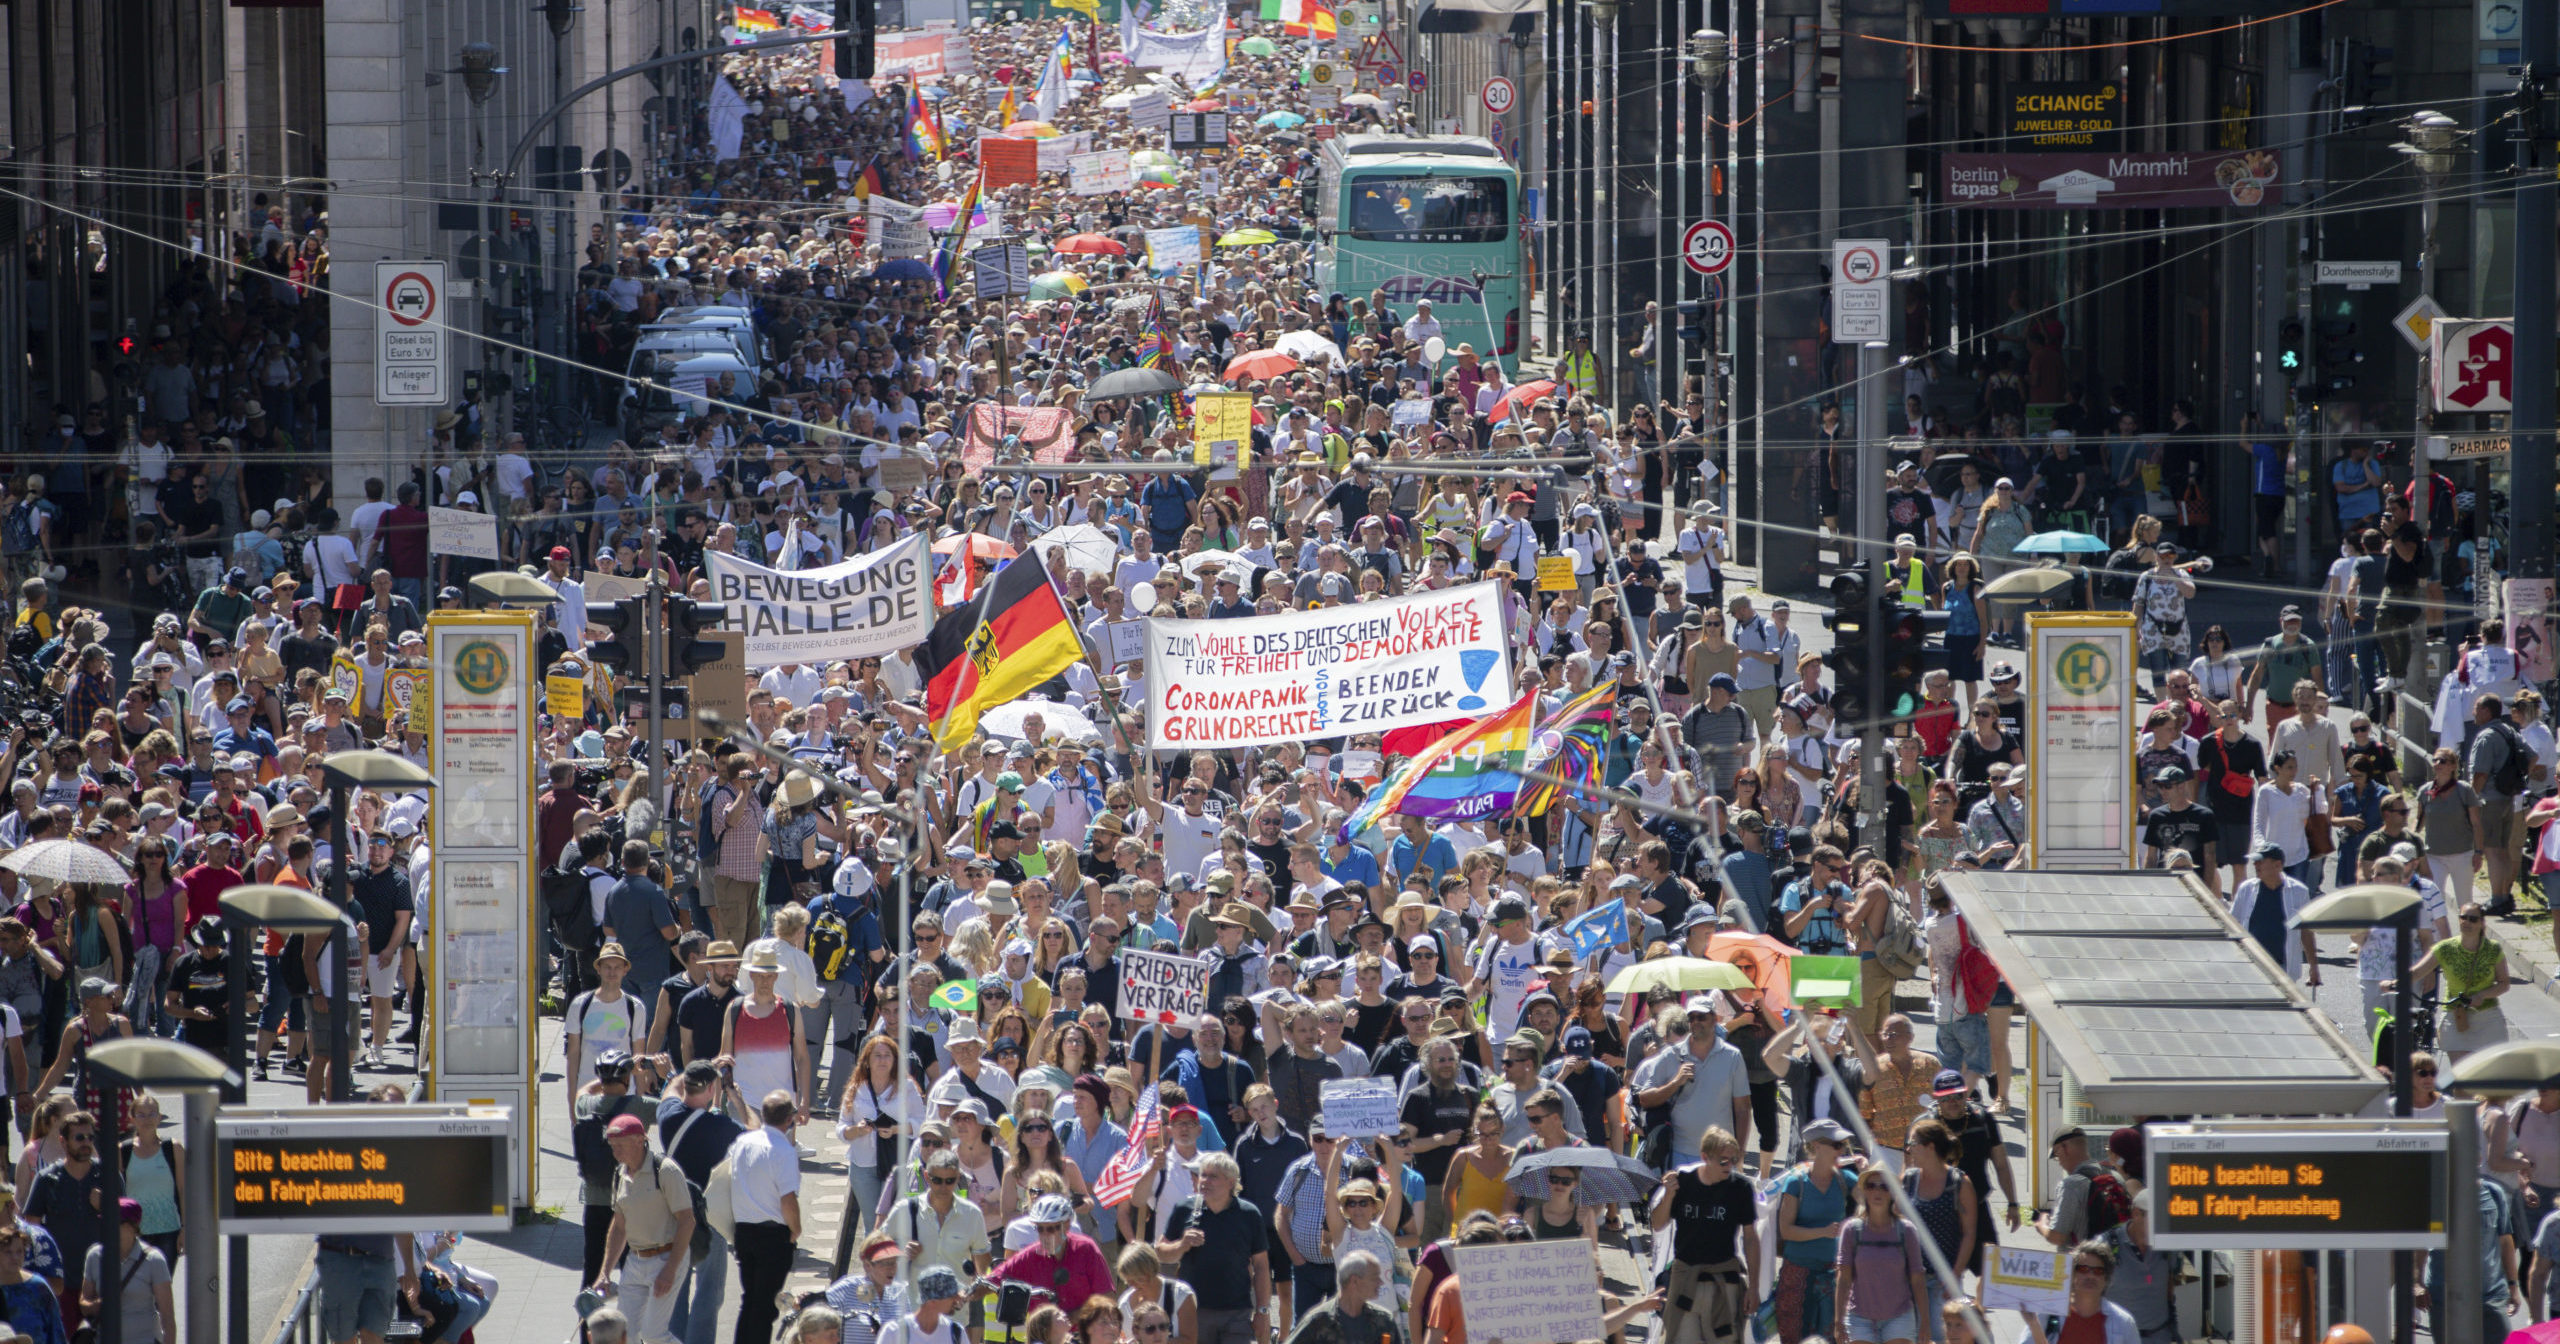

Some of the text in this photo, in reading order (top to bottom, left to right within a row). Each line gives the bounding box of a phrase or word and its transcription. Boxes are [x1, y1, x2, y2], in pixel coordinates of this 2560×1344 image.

[1489, 87, 1508, 103] 30
[2014, 120, 2112, 131] JUWELIER GOLD
[2033, 134, 2094, 144] LEIHHAUS
[1951, 166, 1998, 182] berlin
[2109, 157, 2188, 177] Mmmh!
[1951, 182, 1998, 198] tapas
[1695, 236, 1723, 258] 30
[1352, 253, 1505, 283] REISEN
[1378, 275, 1486, 304] AFAN
[1846, 318, 1876, 326] Anlieger
[389, 336, 432, 344] Diesel bis
[390, 348, 432, 357] Euro 5/V
[392, 370, 431, 380] Anlieger
[403, 382, 420, 391] frei
[720, 558, 917, 602] BEWEGUNG
[724, 587, 918, 637] HALLE.DE
[752, 642, 781, 651] SELBST
[782, 640, 822, 650] BEWEGEN
[824, 639, 838, 648] ALS
[839, 634, 873, 646] BEWEGT
[874, 632, 886, 642] ZU
[887, 622, 918, 640] WERDEN
[1166, 598, 1478, 657] ZUM WOHLE DES DEUTSCHEN VOLKES
[1184, 620, 1482, 677] FÜR FREIHEIT UND DEMOKRATIE
[468, 652, 494, 682] H
[2072, 654, 2096, 684] H
[1338, 666, 1440, 700] BEENDEN
[1314, 668, 1334, 730] SOFORT
[1164, 710, 1324, 741] GRUNDRECHTE
[1339, 691, 1454, 724] ZURÜCK
[453, 760, 461, 768] 12
[1122, 954, 1206, 992] FRIEDENS
[1500, 979, 1524, 988] berlin
[1123, 983, 1202, 1016] VERTRAG
[234, 1124, 490, 1136] Linie Ziel Abfahrt in
[1351, 1118, 1384, 1129] VIREN
[2171, 1139, 2430, 1150] Linie Ziel Abfahrt in
[234, 1148, 386, 1171] Bitte beachten Sie
[2168, 1164, 2323, 1186] Bitte beachten Sie
[235, 1179, 405, 1206] den Fahrplanaushang
[2168, 1194, 2342, 1220] den Fahrplanaushang
[1459, 1245, 1587, 1266] WEDER ALTE NOCH
[1464, 1268, 1501, 1285] NEUE
[1566, 1282, 1598, 1297] DURCH
[1500, 1324, 1542, 1338] ENDLICH
